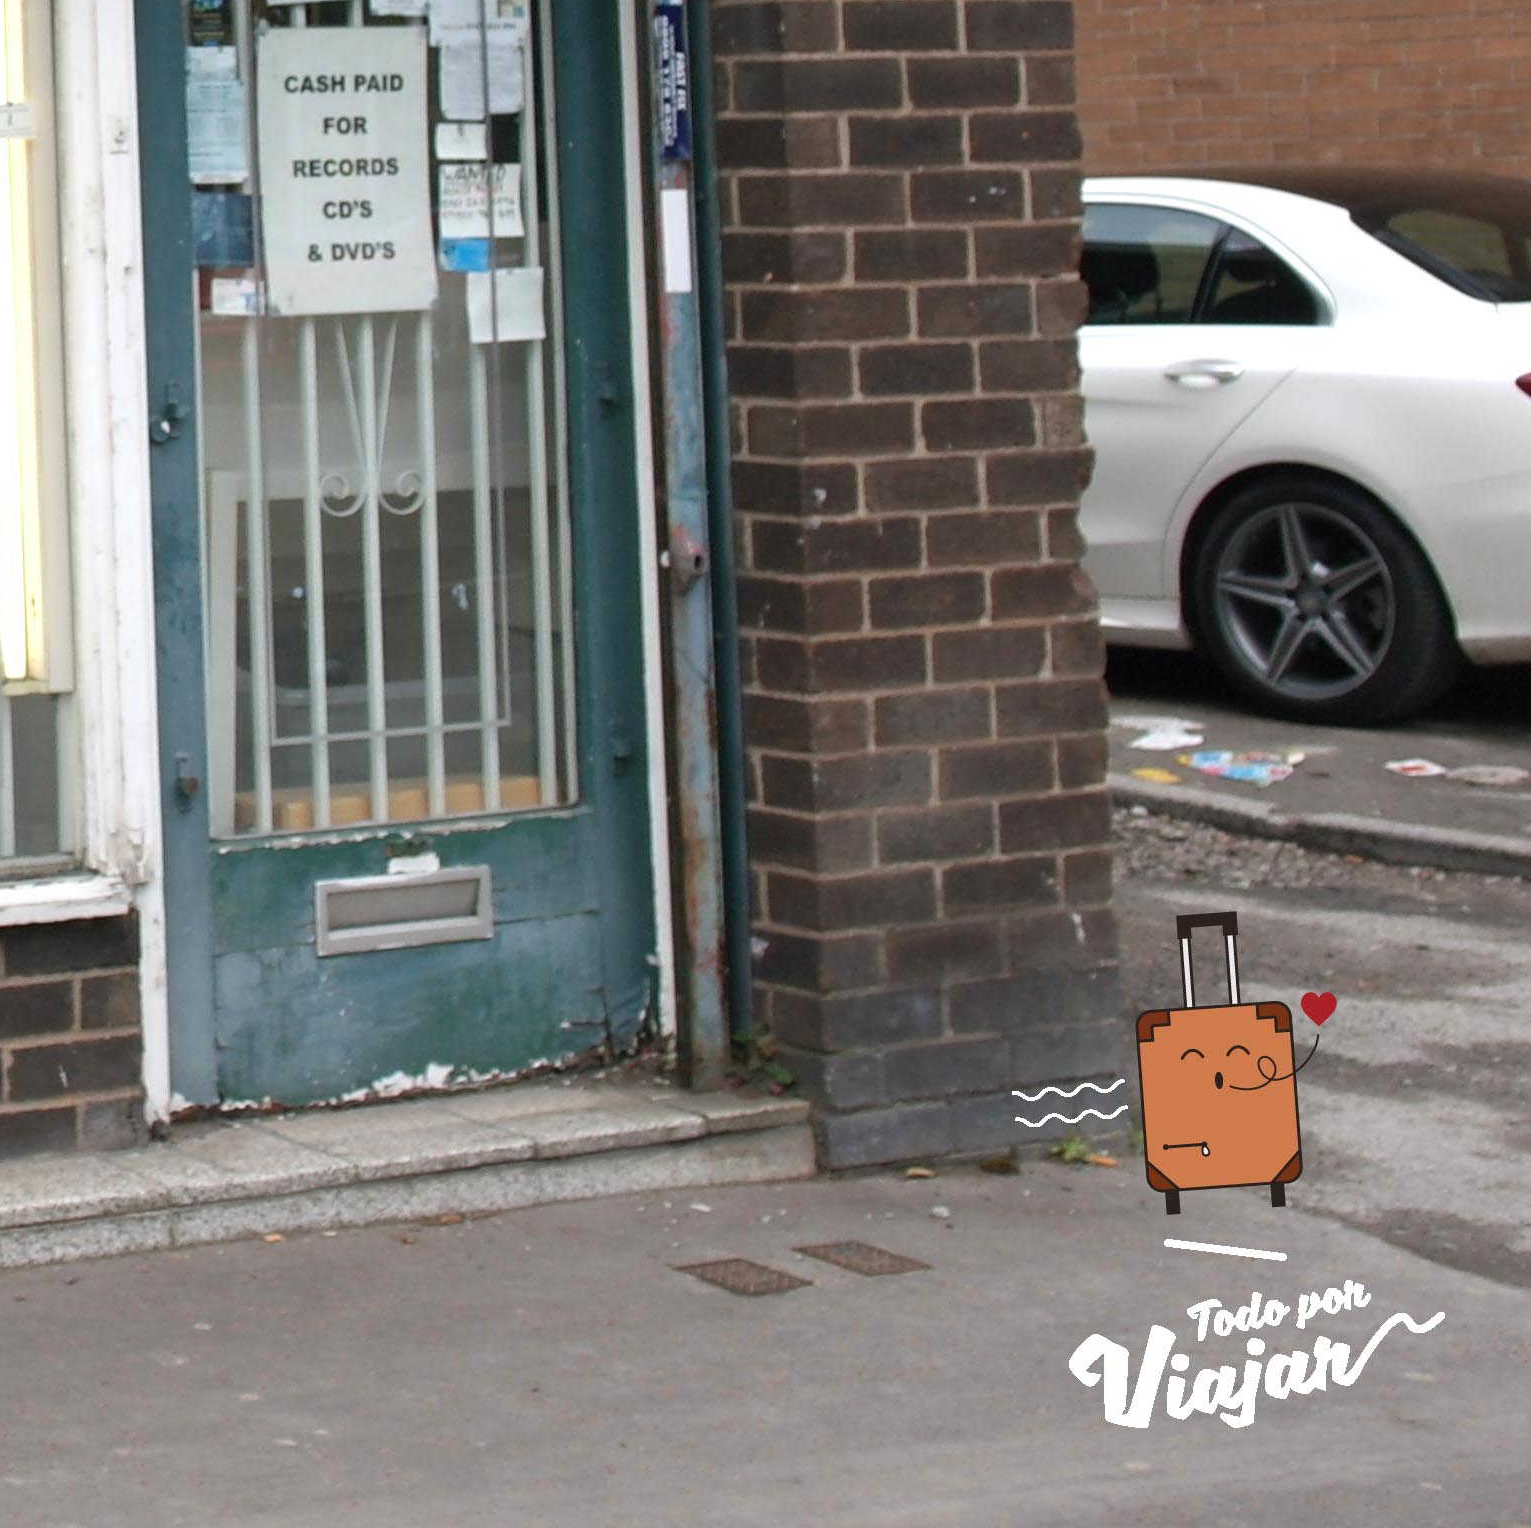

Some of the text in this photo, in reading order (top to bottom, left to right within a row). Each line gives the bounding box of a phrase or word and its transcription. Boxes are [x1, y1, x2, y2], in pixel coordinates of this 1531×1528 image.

[284, 74, 404, 94] CASH PAID
[322, 117, 368, 134] FOR
[292, 158, 400, 178] RECORDS
[322, 200, 373, 219] CD'S
[307, 242, 396, 262] & DVD'S
